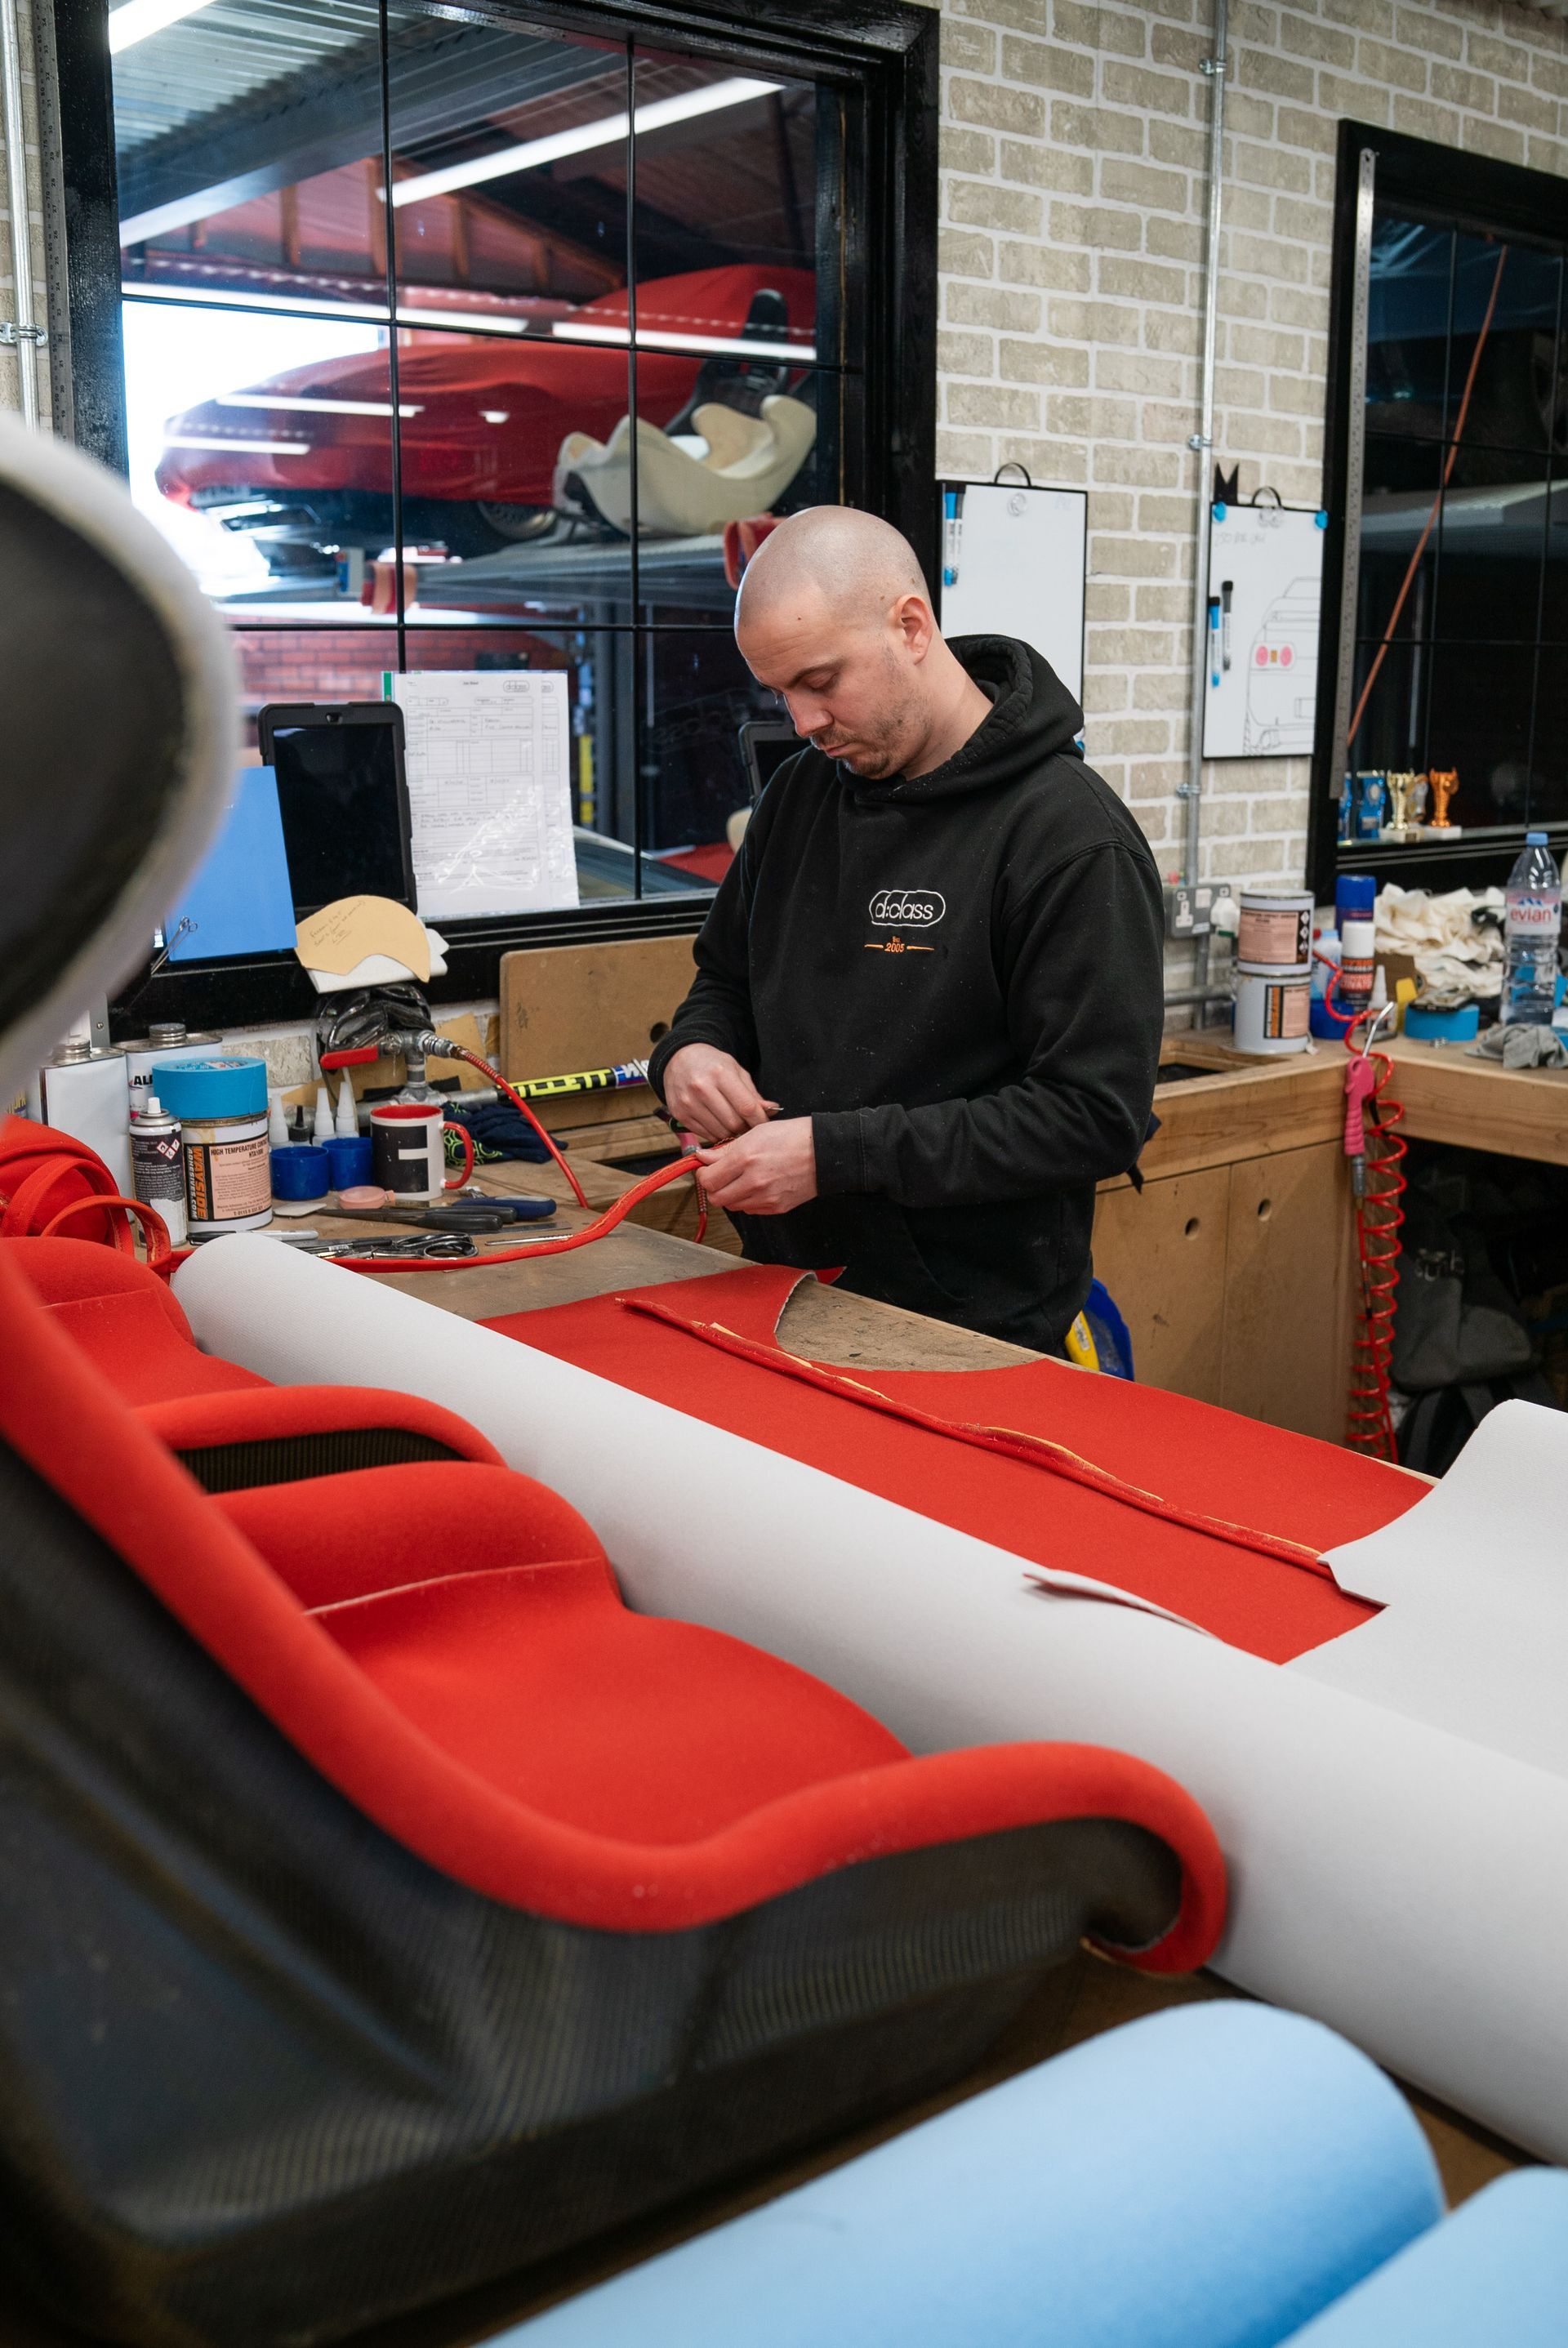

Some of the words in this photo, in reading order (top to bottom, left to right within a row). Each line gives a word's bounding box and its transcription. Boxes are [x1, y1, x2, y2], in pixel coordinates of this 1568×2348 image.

[1511, 907, 1552, 923] evian
[884, 942, 905, 953] 2005
[225, 1143, 257, 1155] TEMPERATURE
[187, 1147, 198, 1220] ADHESIVES.COM
[191, 1146, 208, 1220] WAYSIDE
